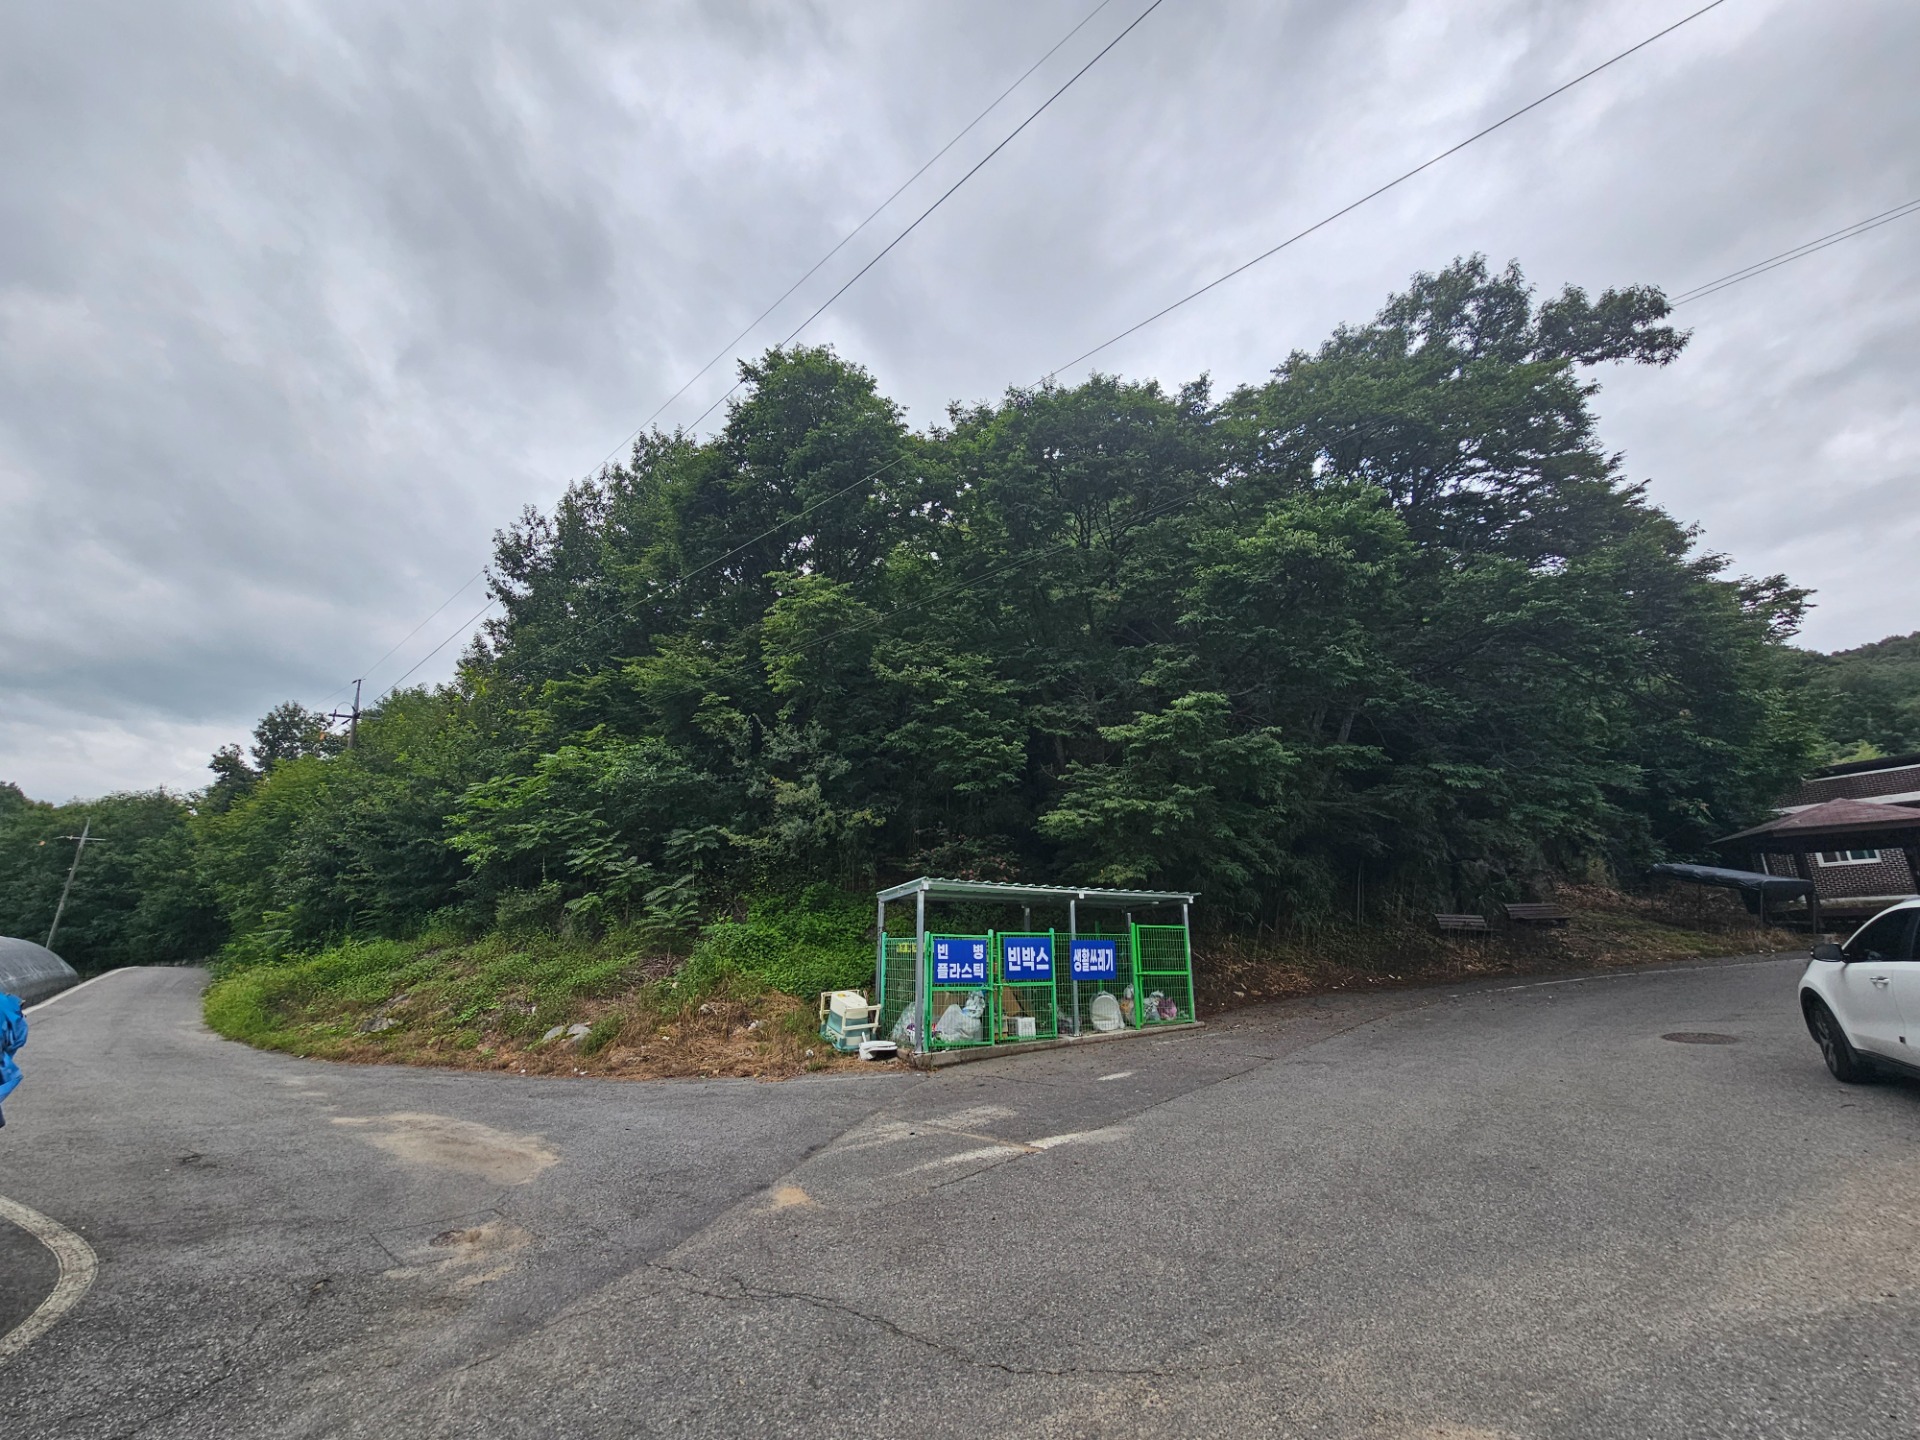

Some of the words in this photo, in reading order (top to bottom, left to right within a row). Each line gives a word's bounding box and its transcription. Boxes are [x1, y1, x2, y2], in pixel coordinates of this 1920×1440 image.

[937, 944, 948, 959] 빈
[973, 944, 983, 959] 병
[1008, 947, 1049, 971] 빈박스
[1074, 949, 1113, 971] 생활쓰레기
[937, 963, 983, 978] 플라스틱
